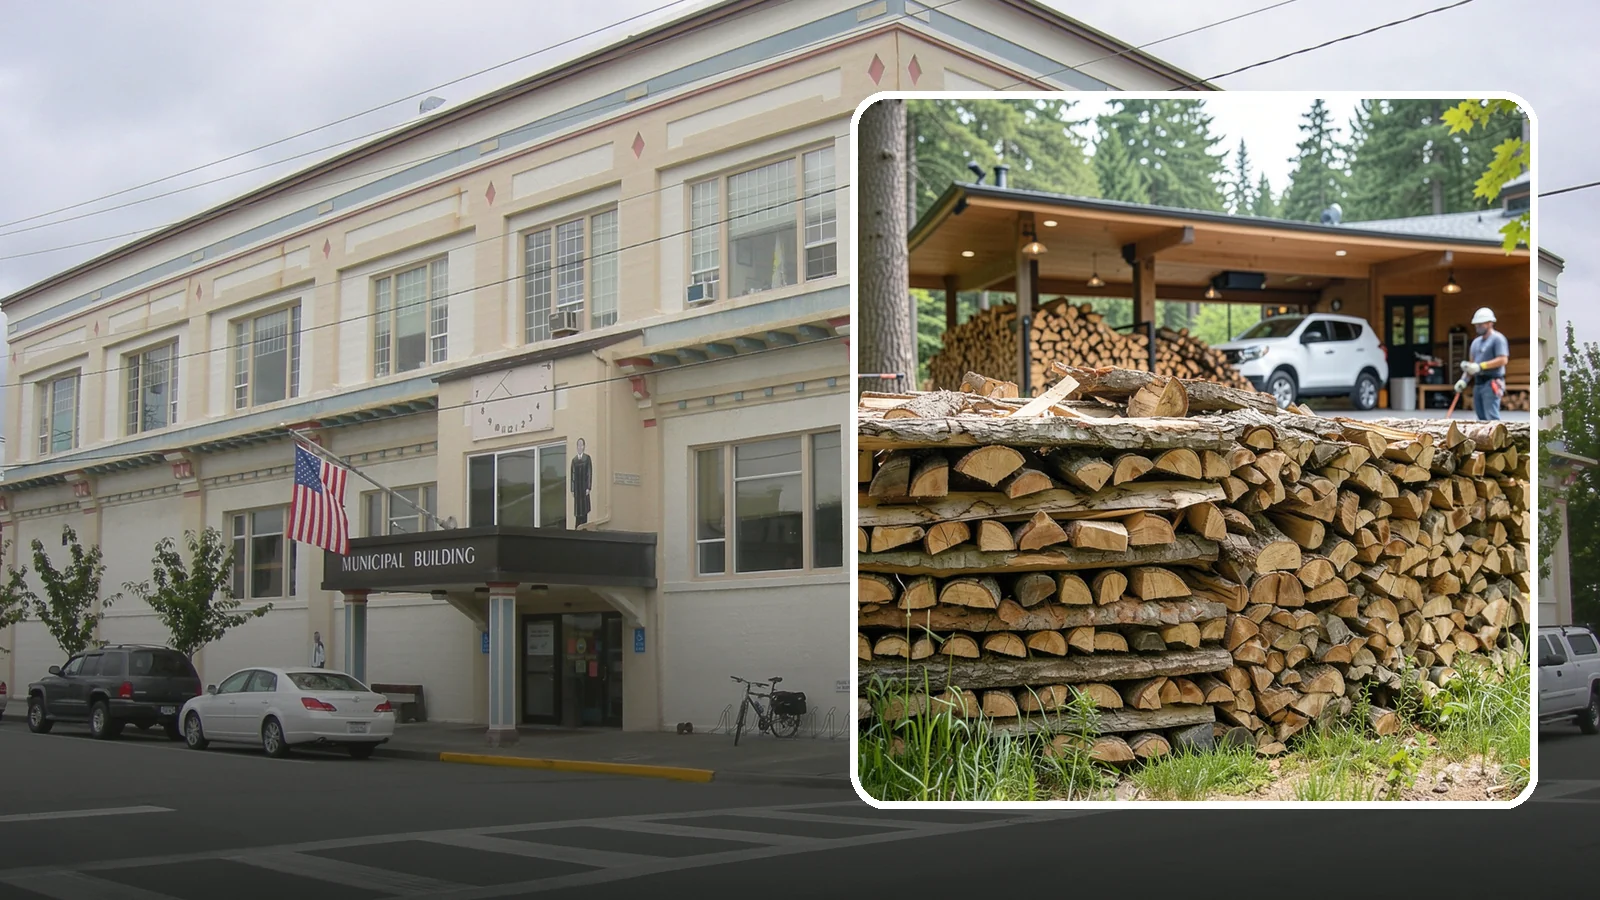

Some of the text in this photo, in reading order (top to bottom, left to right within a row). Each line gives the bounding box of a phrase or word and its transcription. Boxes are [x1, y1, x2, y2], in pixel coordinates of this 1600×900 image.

[475, 390, 479, 398] 7
[481, 407, 485, 415] 8
[488, 418, 492, 426] 9
[529, 414, 533, 422] 3
[495, 424, 500, 432] 10
[521, 420, 525, 428] 2
[342, 546, 475, 572] MUNICIPAL BUILDING
